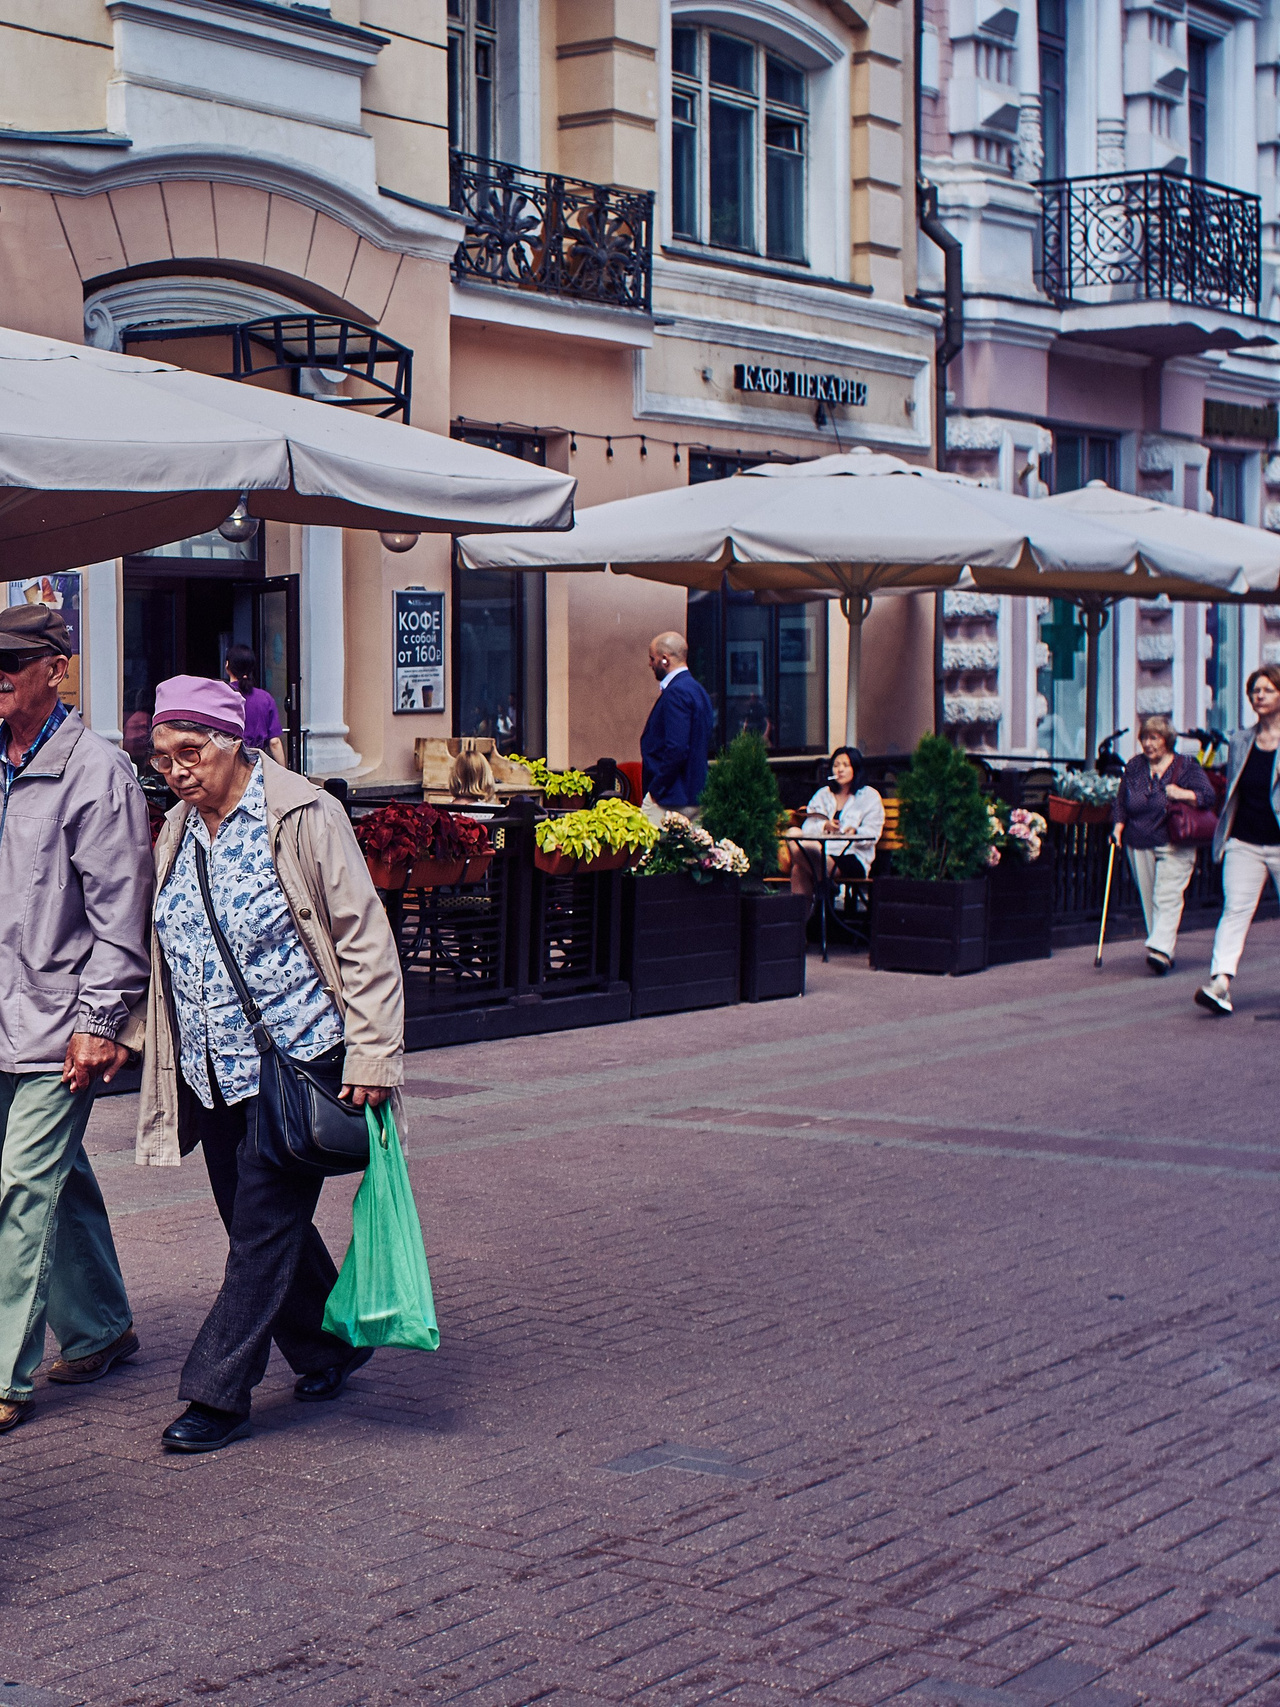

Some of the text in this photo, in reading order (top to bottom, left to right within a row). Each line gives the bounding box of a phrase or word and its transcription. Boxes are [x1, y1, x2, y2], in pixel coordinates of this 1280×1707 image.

[741, 364, 868, 406] КАФЕ ПЕКАРНЯ
[398, 611, 440, 631] КОФЕ
[410, 631, 437, 645] собой
